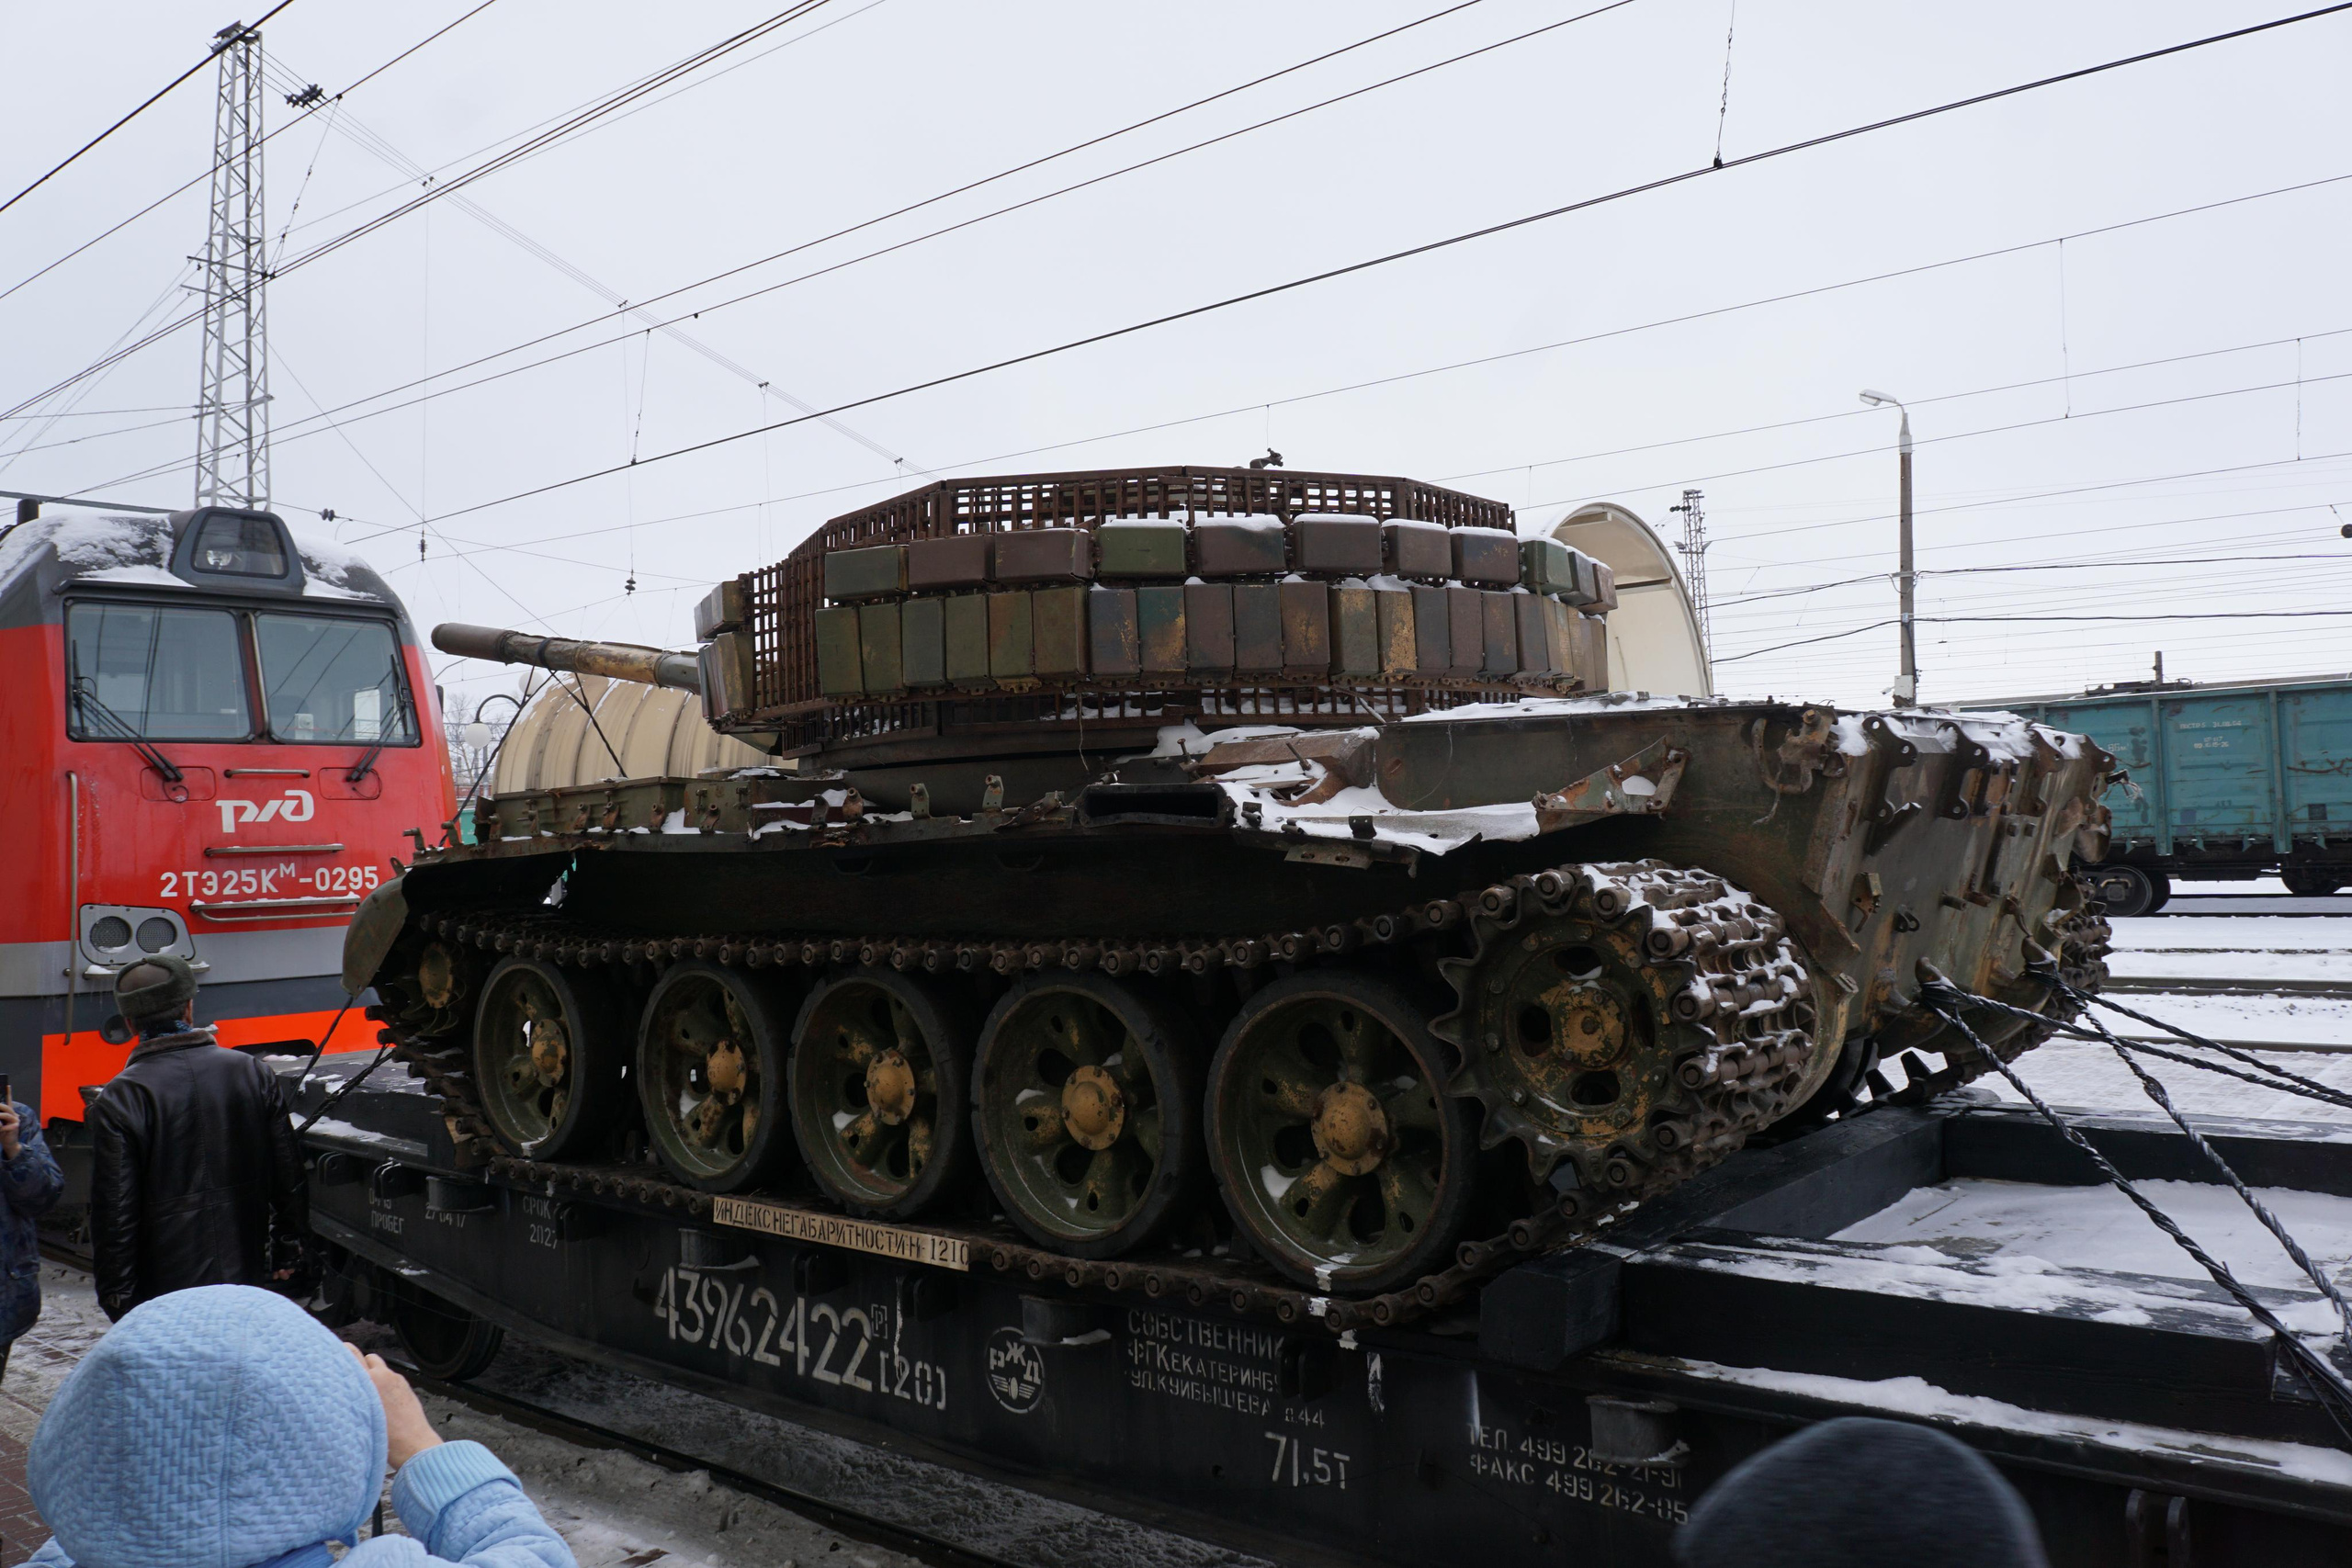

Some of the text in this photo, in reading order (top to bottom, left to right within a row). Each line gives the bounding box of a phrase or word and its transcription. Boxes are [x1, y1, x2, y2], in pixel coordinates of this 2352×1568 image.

[371, 1209, 405, 1235] ПРОБЕГ
[523, 1194, 552, 1221] СРОК
[715, 1198, 772, 1231] ИНДЕКС
[654, 1266, 874, 1393] 43962422
[989, 1339, 1042, 1385] РЖД
[1519, 1435, 1566, 1465] 499
[1469, 1451, 1535, 1486] ФАКС
[1544, 1470, 1594, 1502] 499
